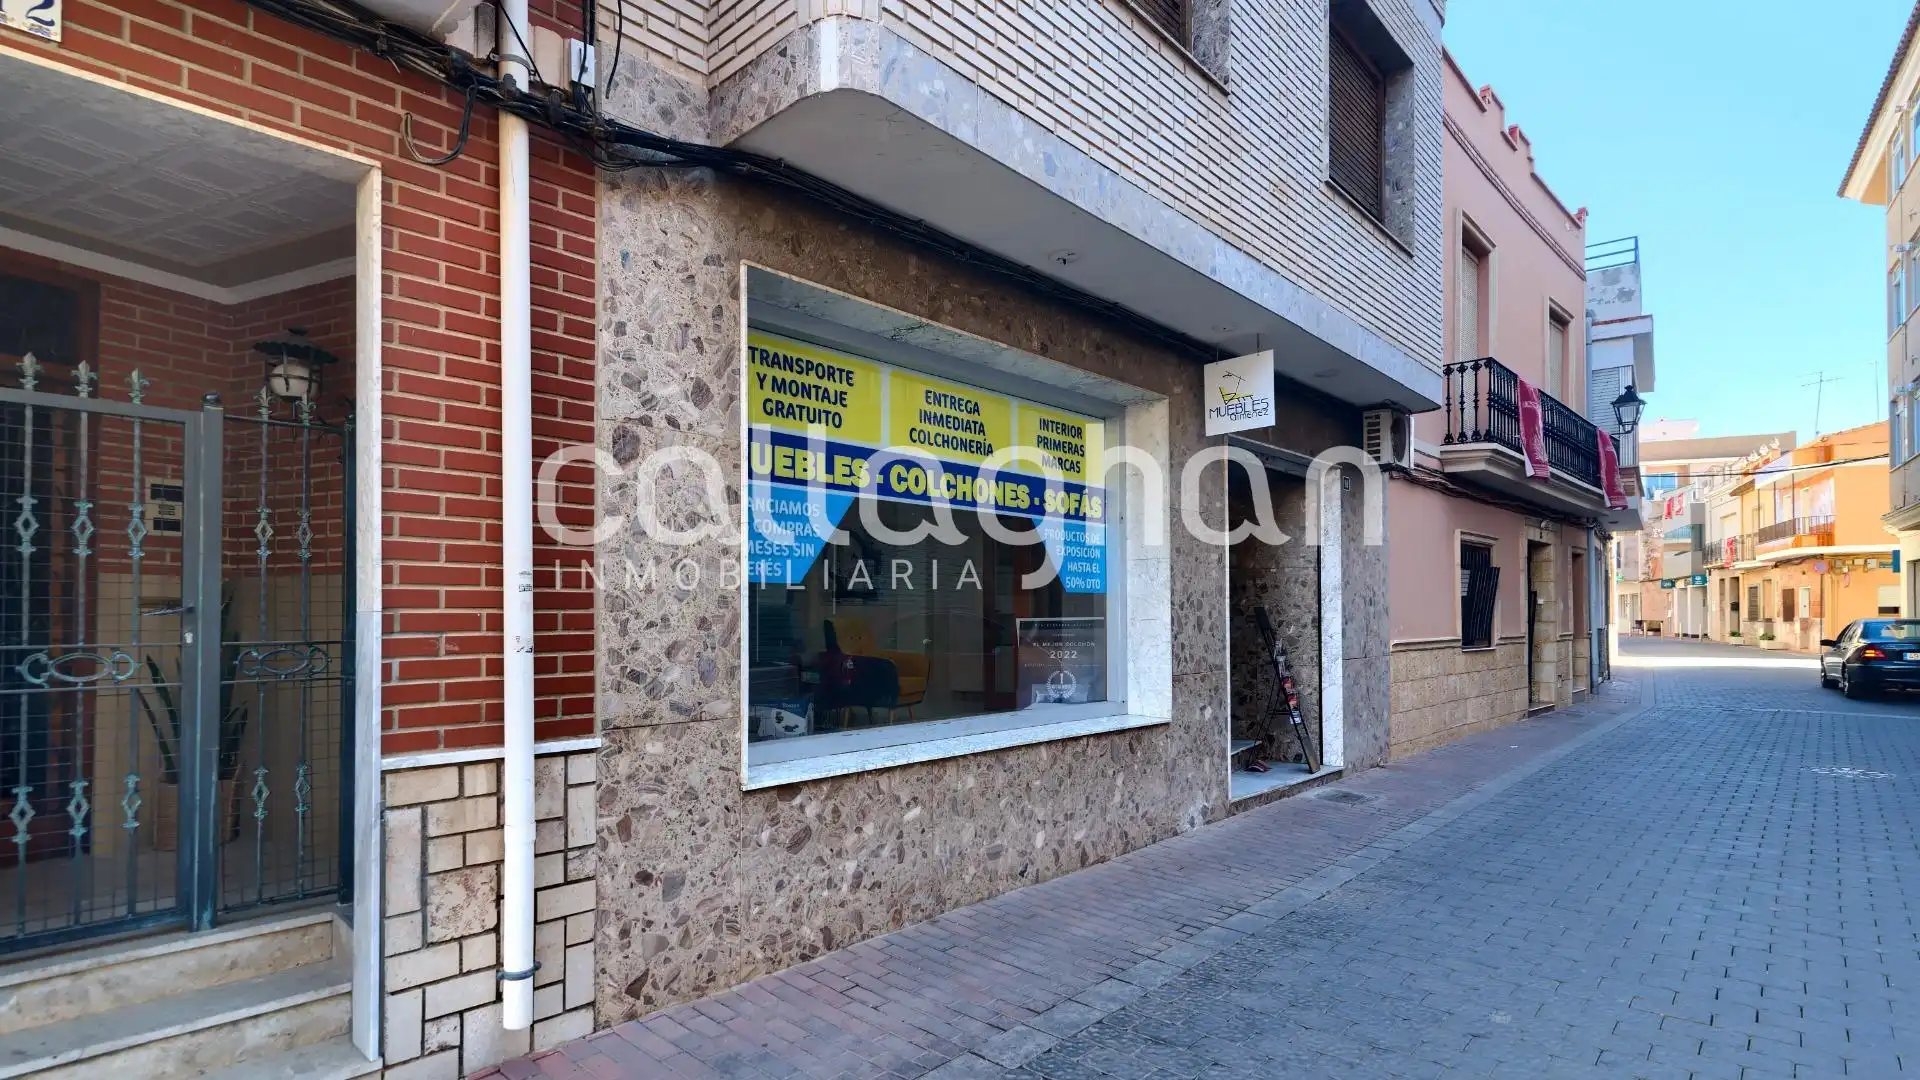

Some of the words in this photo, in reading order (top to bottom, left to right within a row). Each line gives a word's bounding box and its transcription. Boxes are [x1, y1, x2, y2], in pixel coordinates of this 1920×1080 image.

[748, 346, 854, 387] TRANSPORTE
[756, 372, 767, 390] Y
[771, 375, 848, 408] MONTAJE
[762, 397, 842, 428] GRATUITO
[925, 390, 980, 417] ENTREGA
[1209, 398, 1269, 419] MUEBLES
[919, 408, 986, 437] INMEDIATA
[1039, 417, 1083, 440] INTERIOR
[909, 427, 994, 457] COLCHONERÍA
[1036, 434, 1085, 458] PRIMERAS
[1041, 455, 1081, 474] MARCAS
[890, 464, 1031, 510] COLCHONES
[1043, 489, 1102, 519] SOFÁS
[753, 519, 821, 538] COMPRAS
[1044, 528, 1089, 543] PRODUCTOS
[793, 543, 815, 558] SIN
[1056, 545, 1101, 559] EXPOSICIÓN
[1067, 561, 1090, 573] HASTA
[1092, 563, 1101, 574] EL
[1066, 577, 1085, 589] 50%
[1086, 578, 1101, 590] DTO
[1049, 650, 1079, 660] 2022
